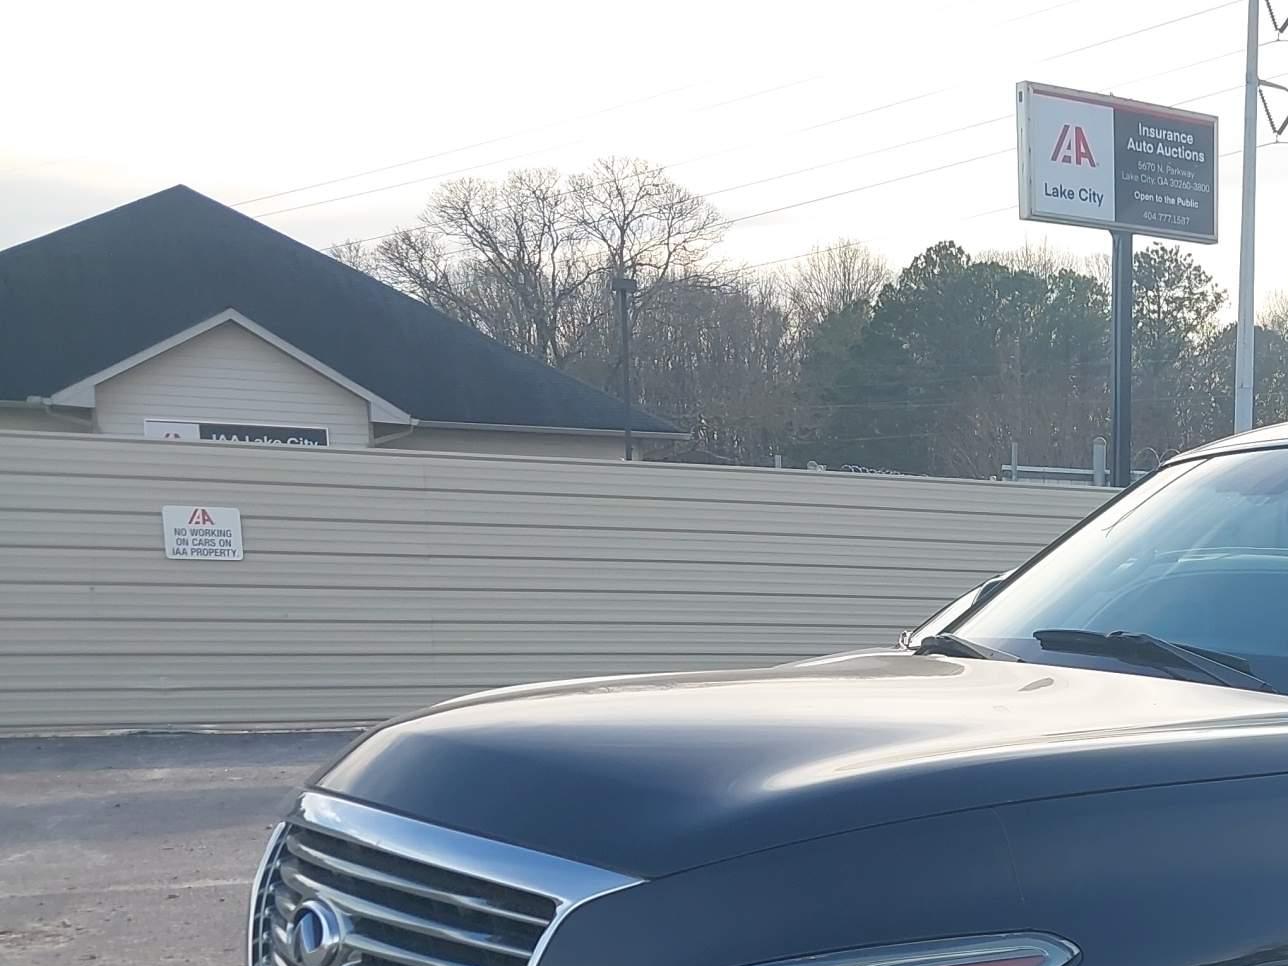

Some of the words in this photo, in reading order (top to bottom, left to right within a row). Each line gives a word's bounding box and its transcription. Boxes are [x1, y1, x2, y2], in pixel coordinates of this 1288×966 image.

[1138, 122, 1194, 145] Insurance
[1127, 137, 1154, 154] Auto
[1156, 141, 1205, 162] Auctions
[1044, 182, 1075, 200] Lake
[1078, 187, 1104, 207] City
[1134, 191, 1154, 202] Open
[1155, 193, 1162, 203] to
[1164, 194, 1175, 205] the
[1177, 197, 1199, 208] Public
[174, 528, 187, 536] NO
[190, 528, 232, 538] WORKING
[176, 537, 189, 546] ON
[191, 538, 216, 547] CARS
[218, 539, 232, 547] ON
[172, 547, 188, 556] IAA
[190, 548, 237, 557] PROPERTY
